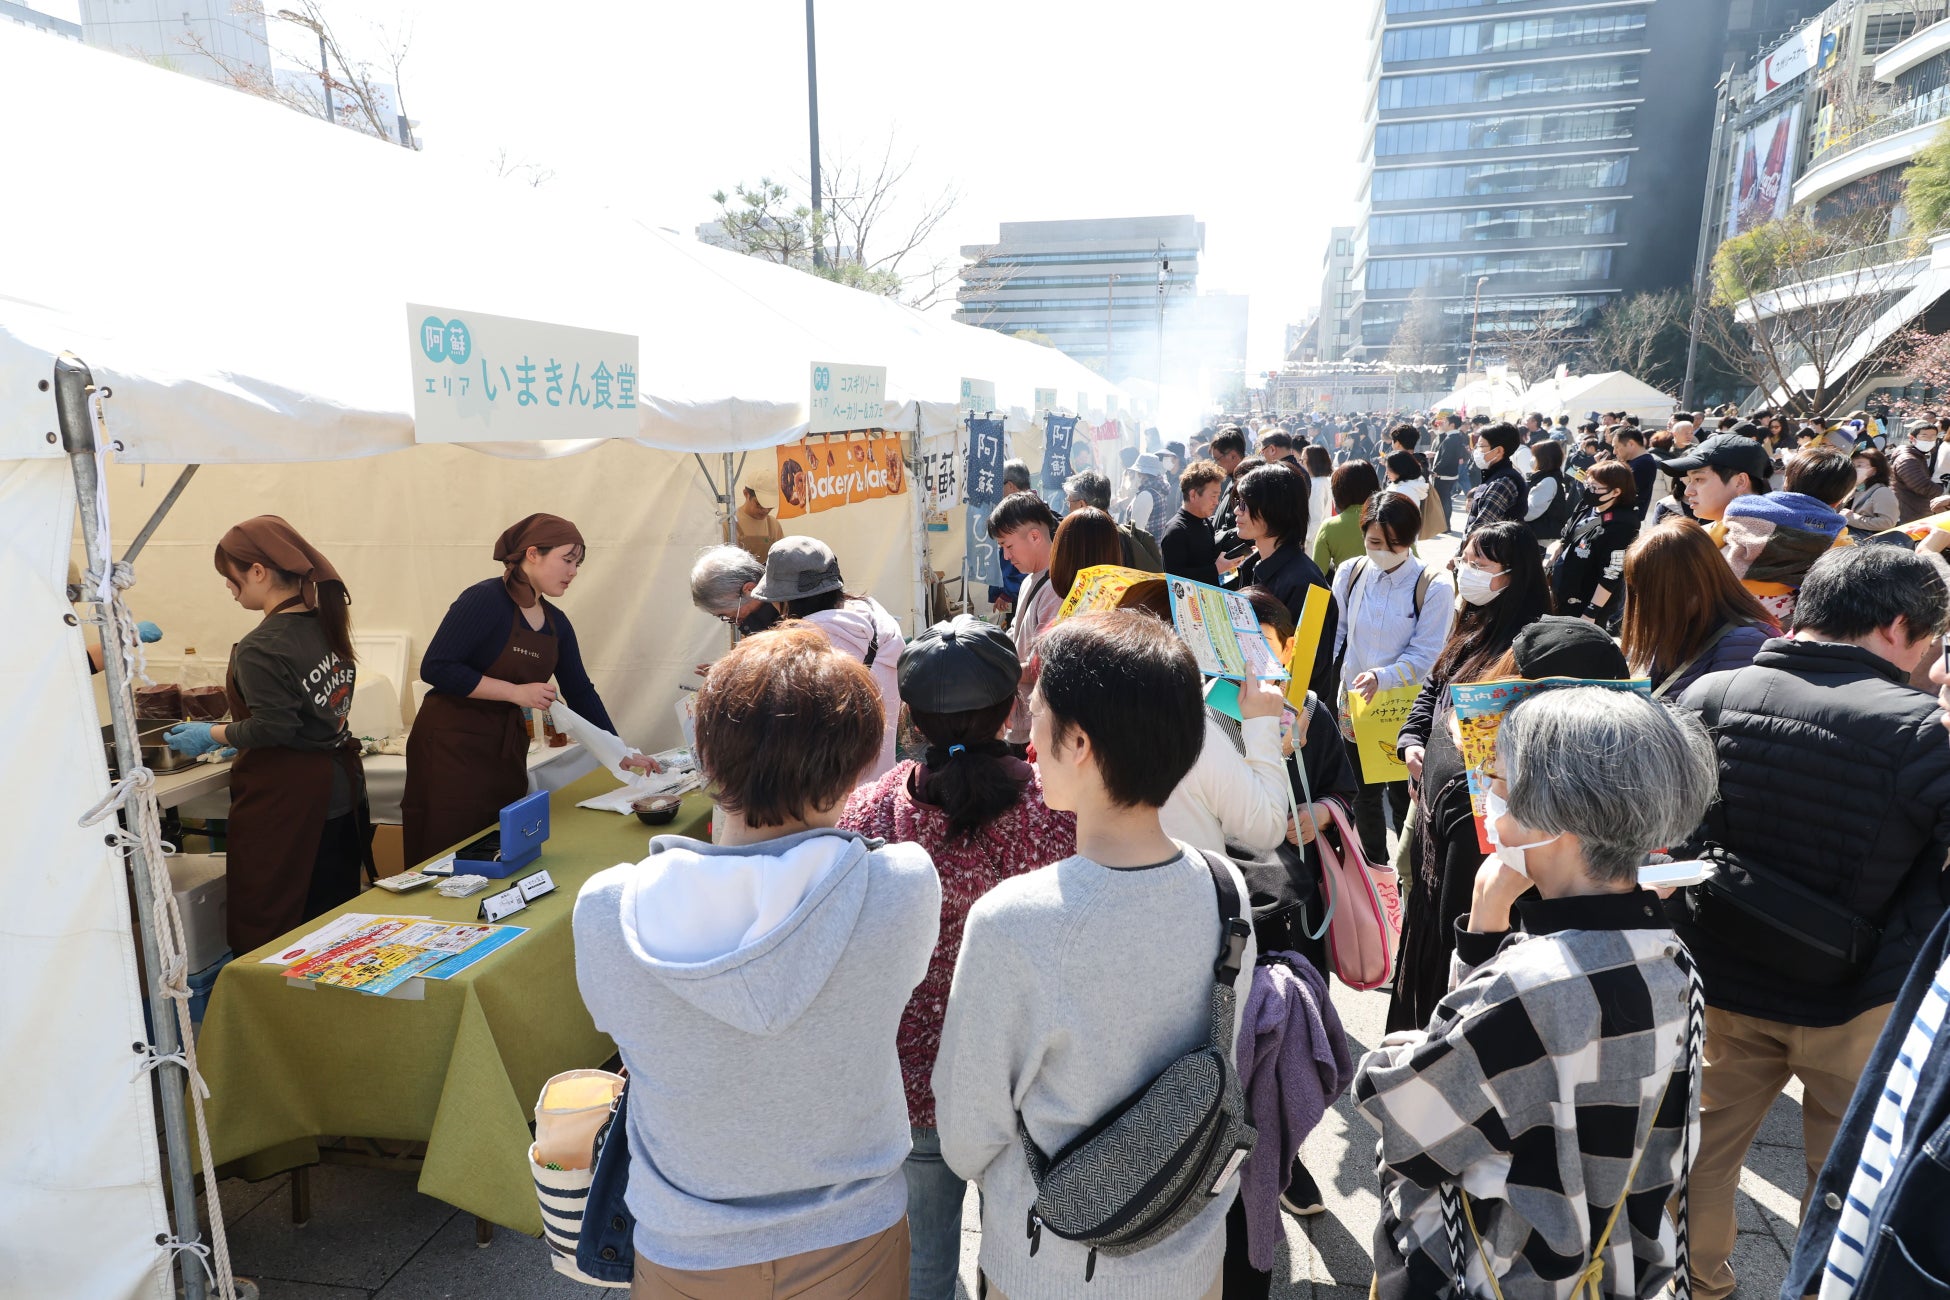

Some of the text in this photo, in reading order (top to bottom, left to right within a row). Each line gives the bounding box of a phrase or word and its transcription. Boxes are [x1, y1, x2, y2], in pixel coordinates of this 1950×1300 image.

[424, 325, 466, 356] 阿蘇
[425, 375, 471, 397] エリア
[481, 355, 636, 410] いまきん食堂
[975, 433, 998, 495] 阿蘇
[1051, 424, 1073, 477] 阿蘇
